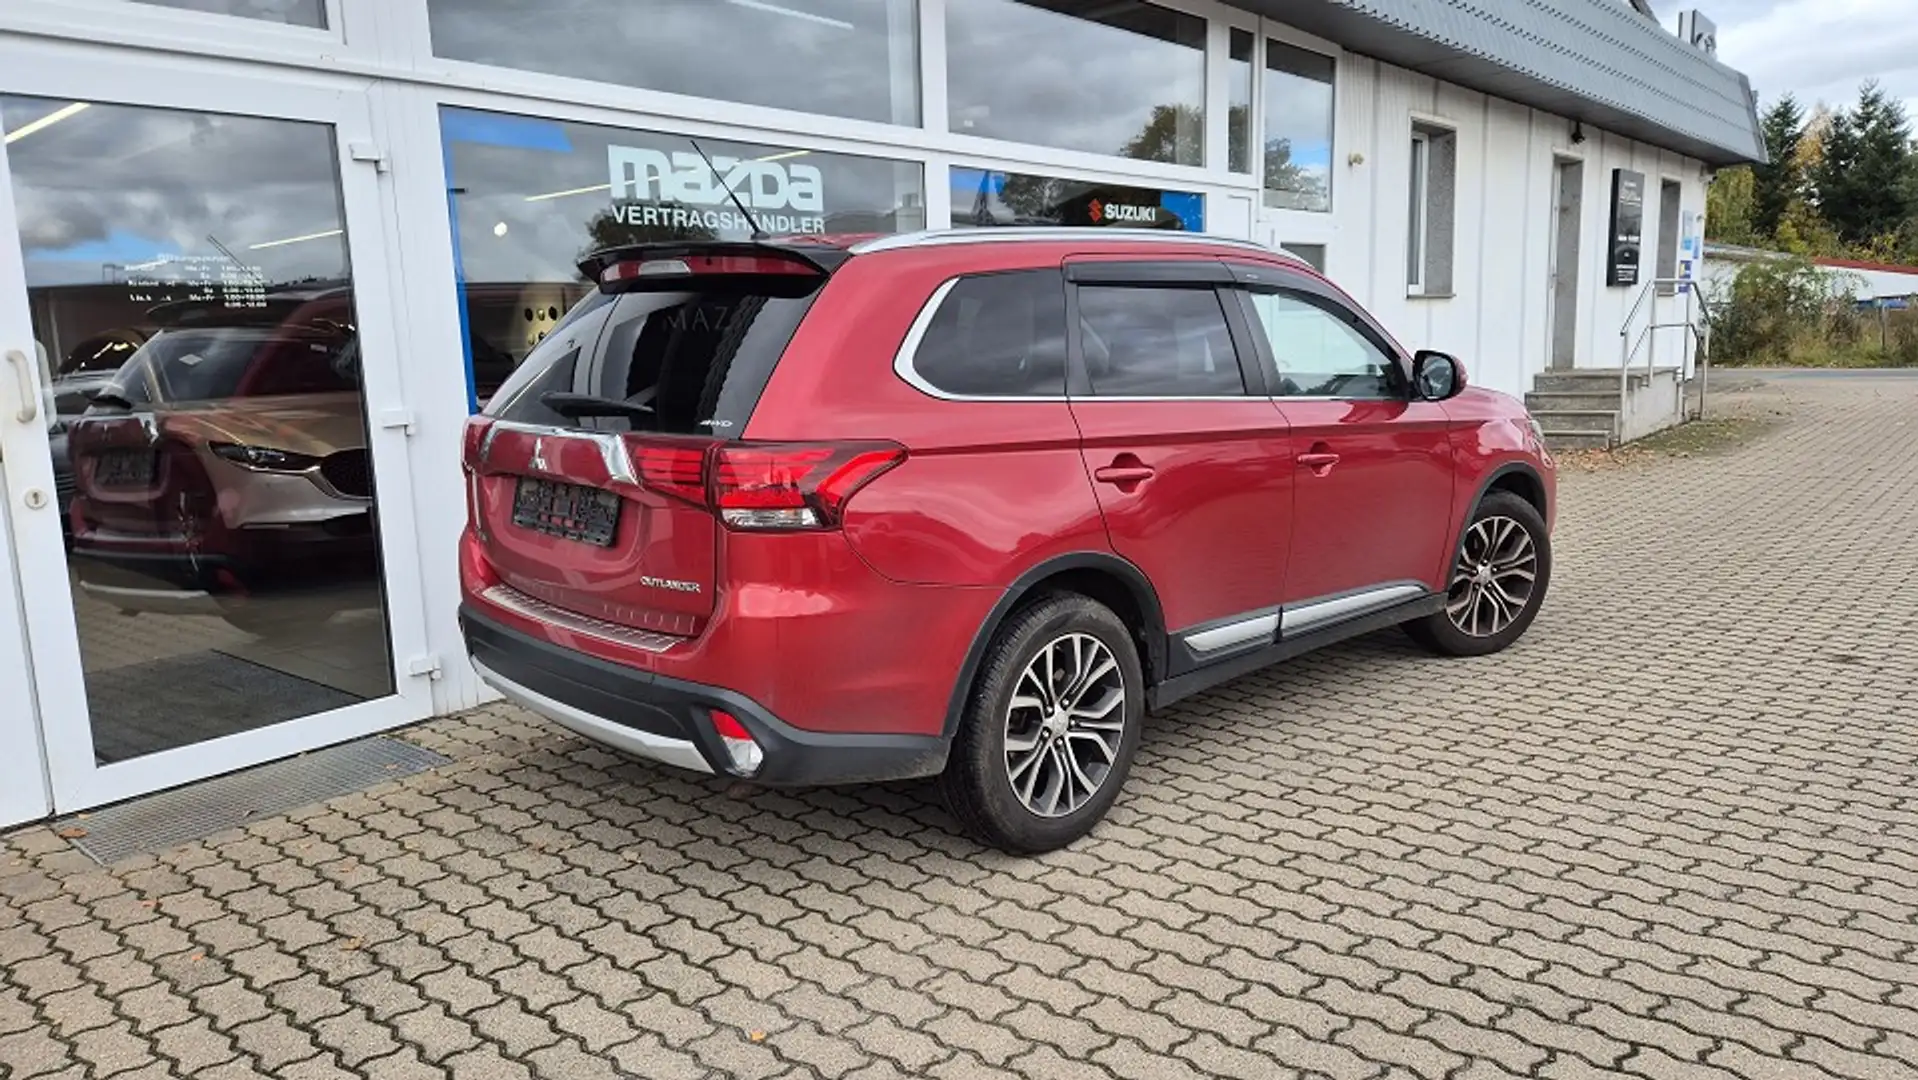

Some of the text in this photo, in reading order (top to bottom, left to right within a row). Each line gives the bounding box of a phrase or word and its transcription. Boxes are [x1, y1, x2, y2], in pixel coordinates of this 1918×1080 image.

[611, 204, 826, 234] VERTRAGSHÄNDLER
[1104, 203, 1156, 221] SUZUKI
[640, 575, 701, 593] OUTLANDER
